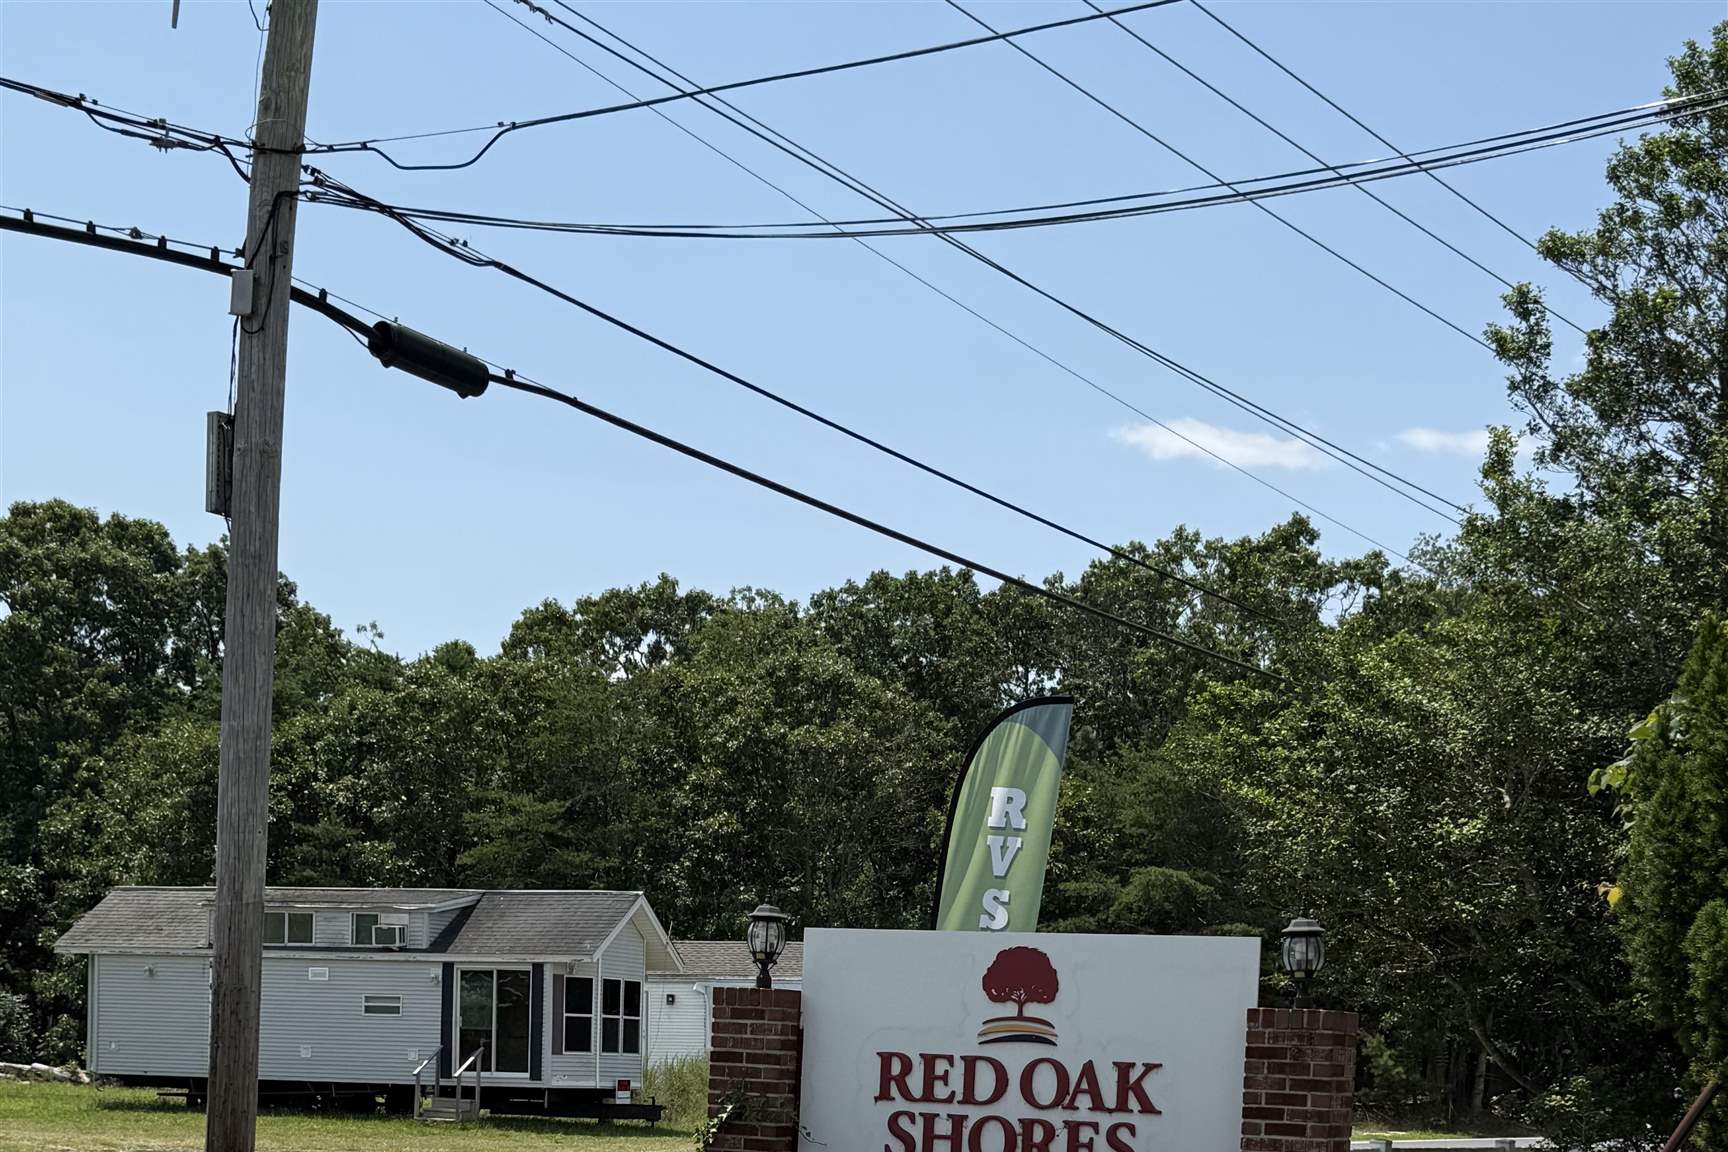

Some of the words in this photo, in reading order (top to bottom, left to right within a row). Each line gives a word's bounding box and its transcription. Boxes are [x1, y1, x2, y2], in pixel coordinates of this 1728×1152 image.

[979, 786, 1027, 930] RVS
[874, 1051, 1009, 1105] RED
[1019, 1057, 1163, 1115] OAK
